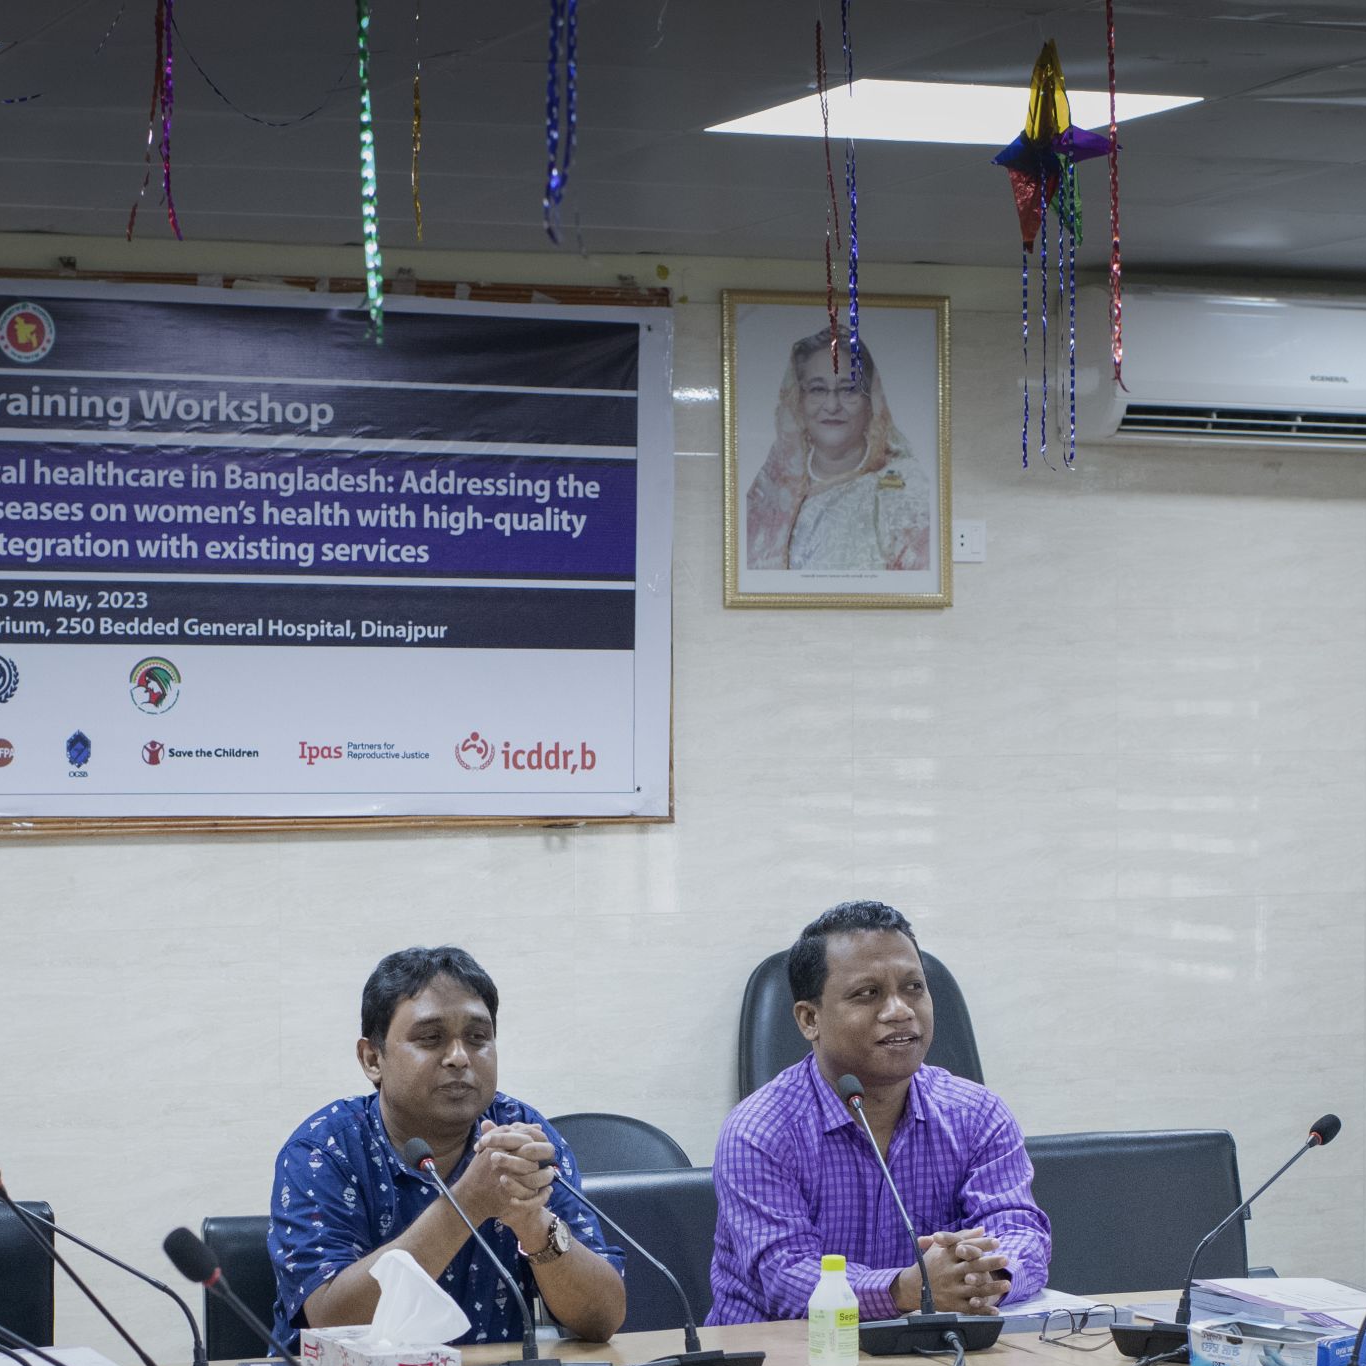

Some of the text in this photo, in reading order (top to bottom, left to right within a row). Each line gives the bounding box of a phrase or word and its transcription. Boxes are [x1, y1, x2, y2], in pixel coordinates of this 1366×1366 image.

[137, 389, 333, 431] Workshop
[34, 460, 184, 488] healthcare
[192, 464, 216, 488] in
[225, 462, 393, 496] Bangladesh:
[400, 469, 550, 501] Addressing
[557, 474, 600, 498] the
[91, 504, 126, 521] on
[263, 500, 349, 526] health
[357, 504, 415, 527] with
[423, 503, 586, 538] high-quality
[136, 534, 198, 558] with
[205, 535, 314, 566] existing
[322, 538, 429, 562] services
[13, 591, 38, 607] 29
[44, 591, 91, 612] May,
[98, 591, 147, 608] 2023
[56, 618, 94, 634] 250
[100, 617, 179, 635] Bedded
[183, 618, 262, 636] General
[269, 620, 355, 640] Hospital,
[362, 621, 447, 642] Dinajpur
[168, 748, 259, 758] Save the Children
[299, 741, 342, 765] Ipas
[347, 742, 395, 750] Partners for
[347, 751, 430, 761] Reproductive Justice
[501, 742, 596, 774] icddr,b
